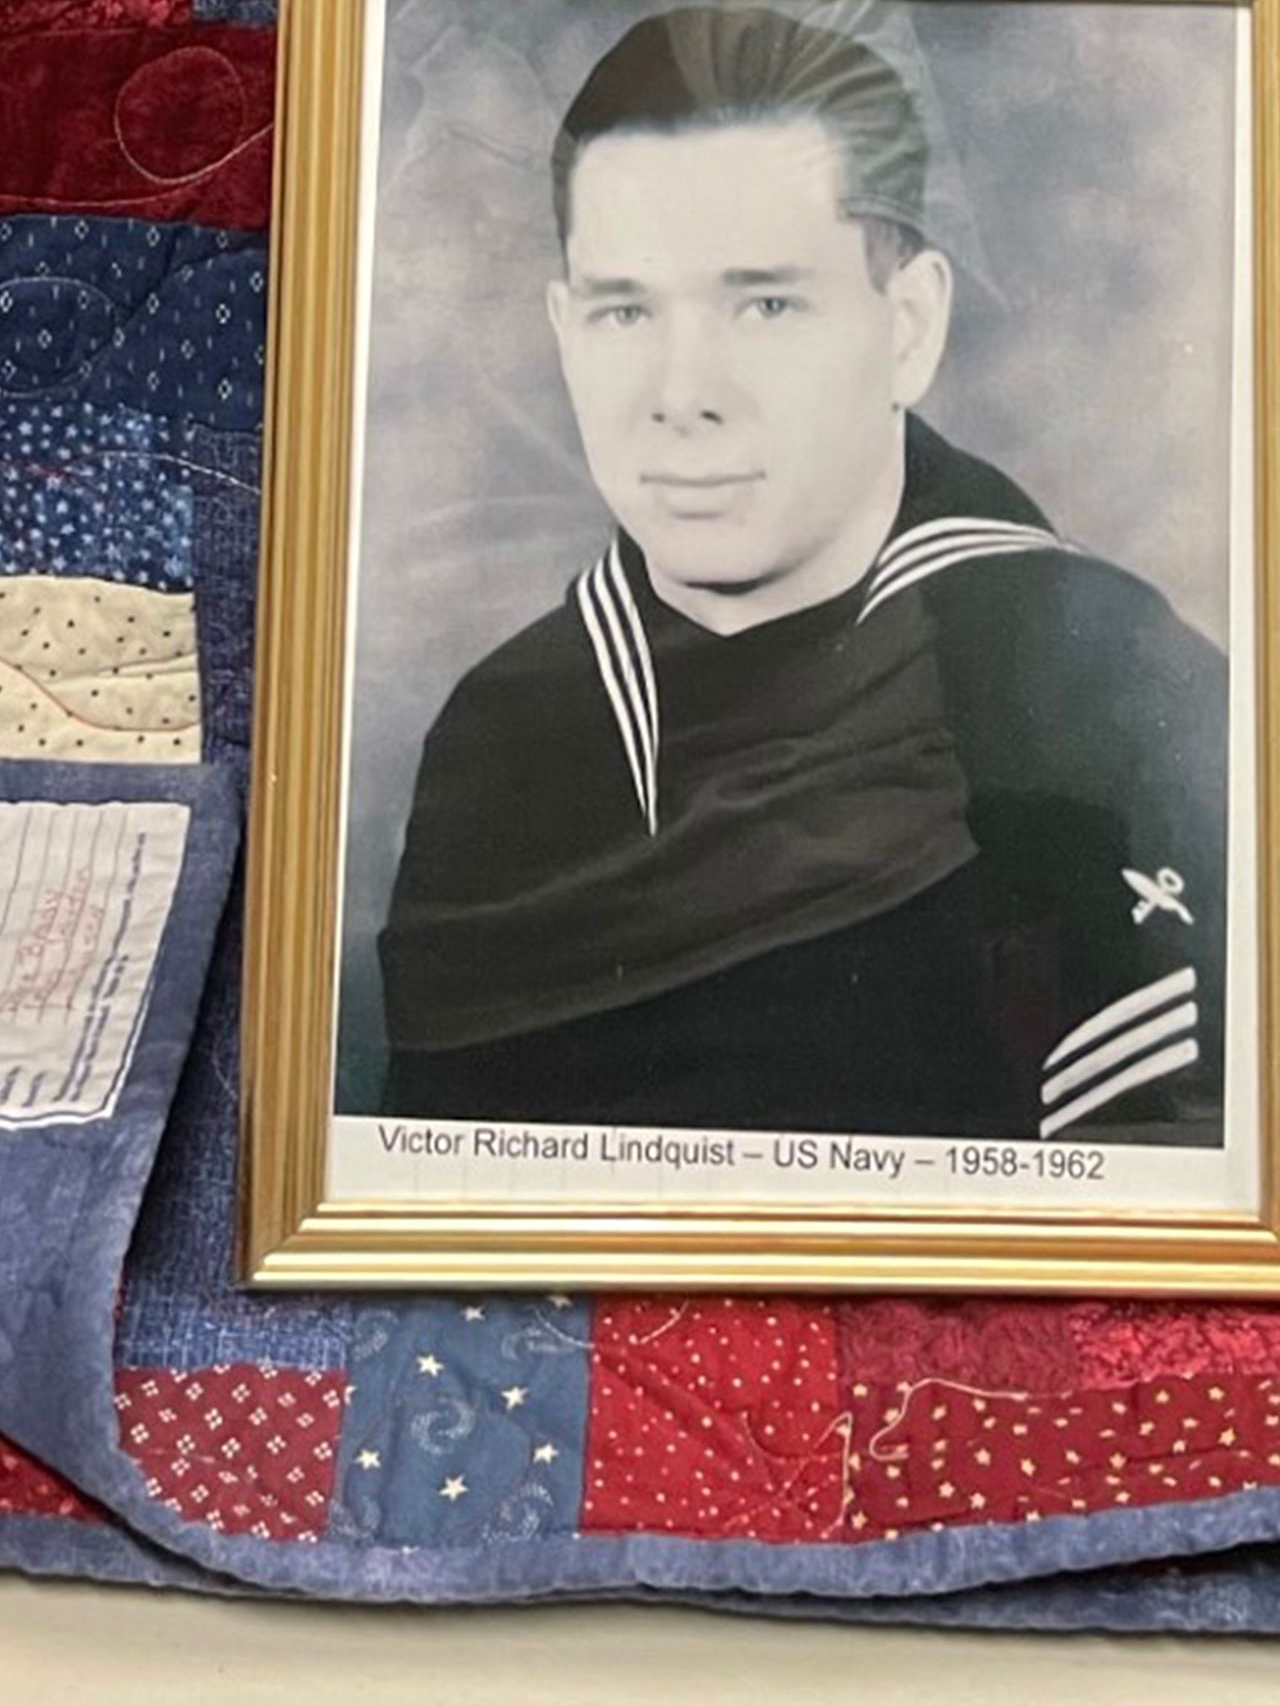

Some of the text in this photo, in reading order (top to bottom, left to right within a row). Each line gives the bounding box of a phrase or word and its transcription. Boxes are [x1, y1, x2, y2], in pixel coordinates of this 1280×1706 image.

[378, 1124, 464, 1156] Victor
[473, 1128, 588, 1161] Richard
[600, 1132, 735, 1170] Lindquist
[773, 1139, 819, 1169] US
[829, 1140, 906, 1180] Navy
[944, 1145, 1106, 1180] 1958-1962
